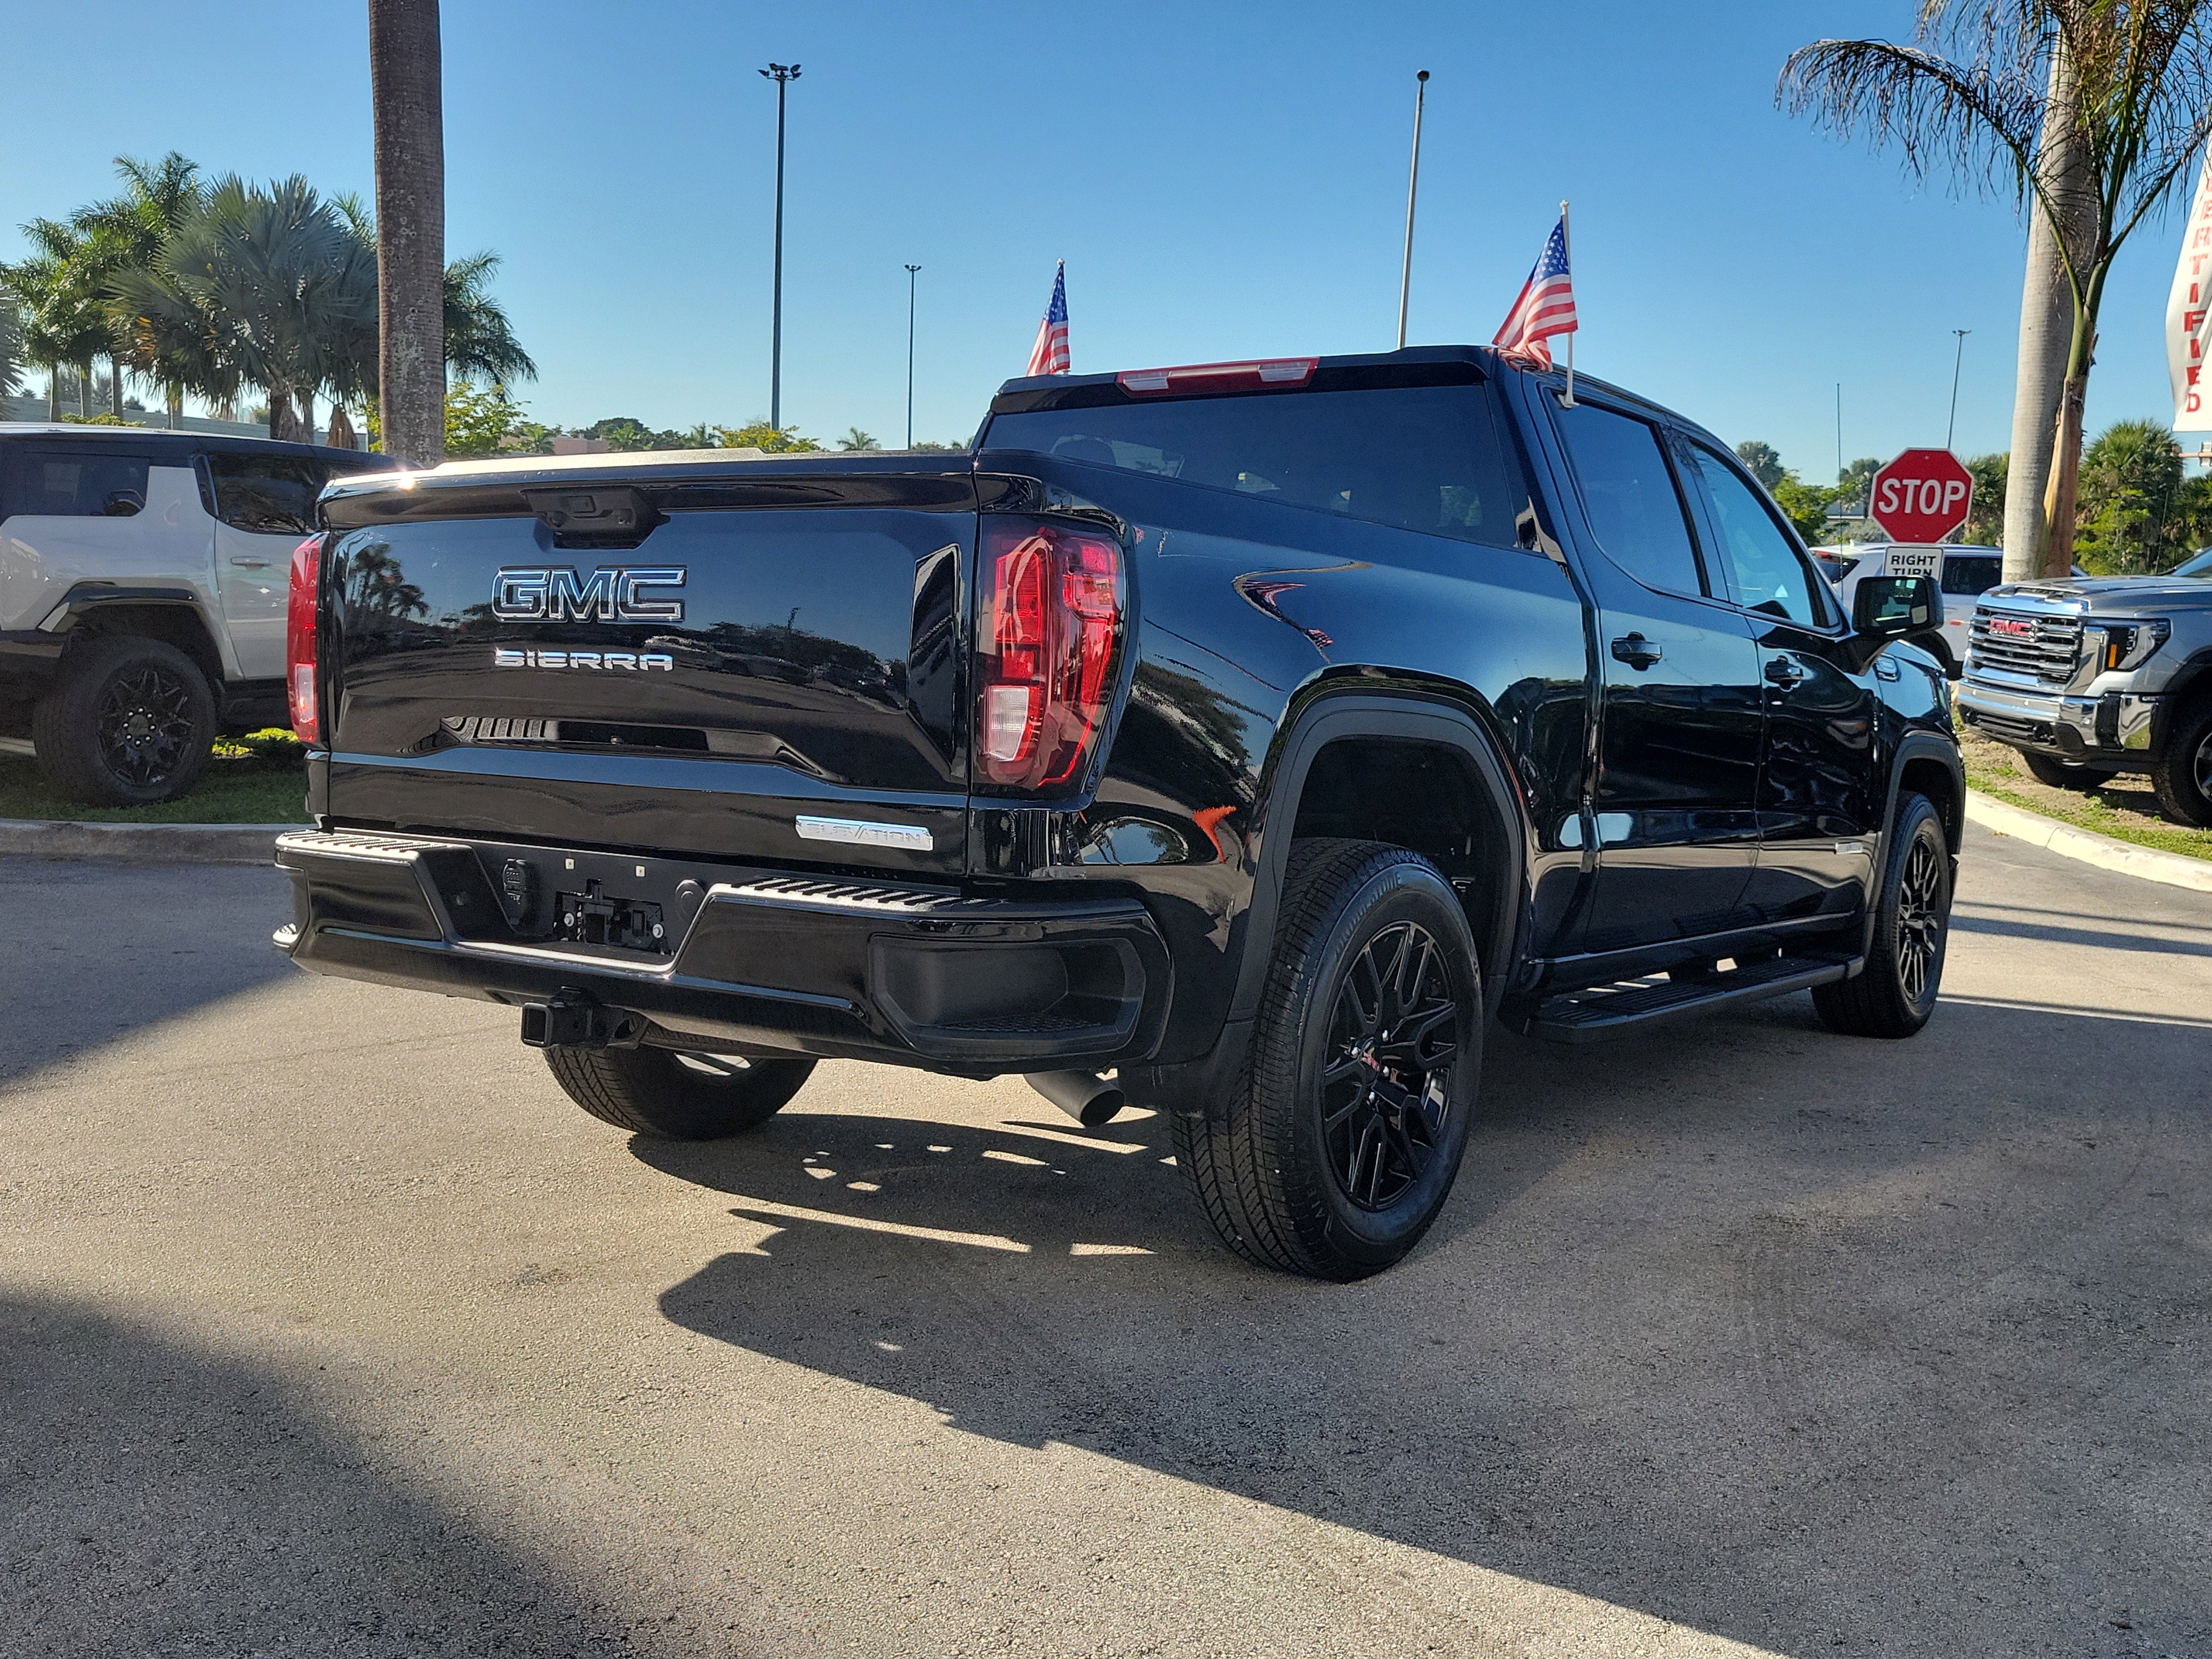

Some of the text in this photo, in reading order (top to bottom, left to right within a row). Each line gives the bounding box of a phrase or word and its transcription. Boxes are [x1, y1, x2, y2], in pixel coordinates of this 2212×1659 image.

[1878, 478, 1966, 515] STOP
[1891, 555, 1937, 566] RIGHT
[1892, 568, 1932, 576] TURN
[491, 565, 687, 624] GMC
[1990, 618, 2033, 636] GMC
[494, 648, 674, 671] SIERRA
[805, 822, 921, 844] ELEVATION
